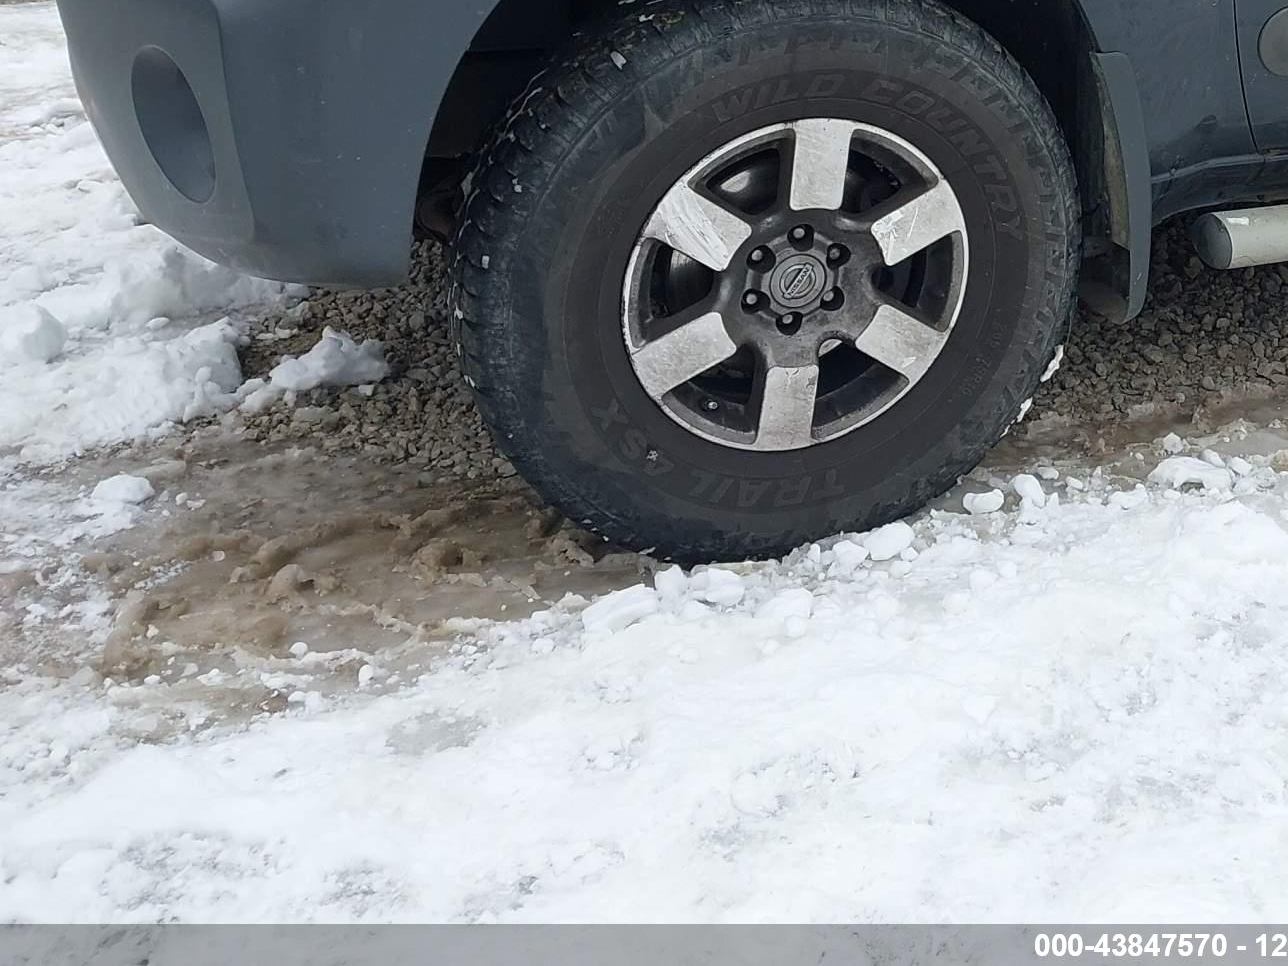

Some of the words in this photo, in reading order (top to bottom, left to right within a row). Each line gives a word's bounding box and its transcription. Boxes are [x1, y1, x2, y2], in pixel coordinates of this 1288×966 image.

[712, 72, 848, 125] WILD
[860, 76, 1027, 243] COUNTRY
[786, 265, 812, 298] NISSAN
[689, 467, 845, 508] TRAIL
